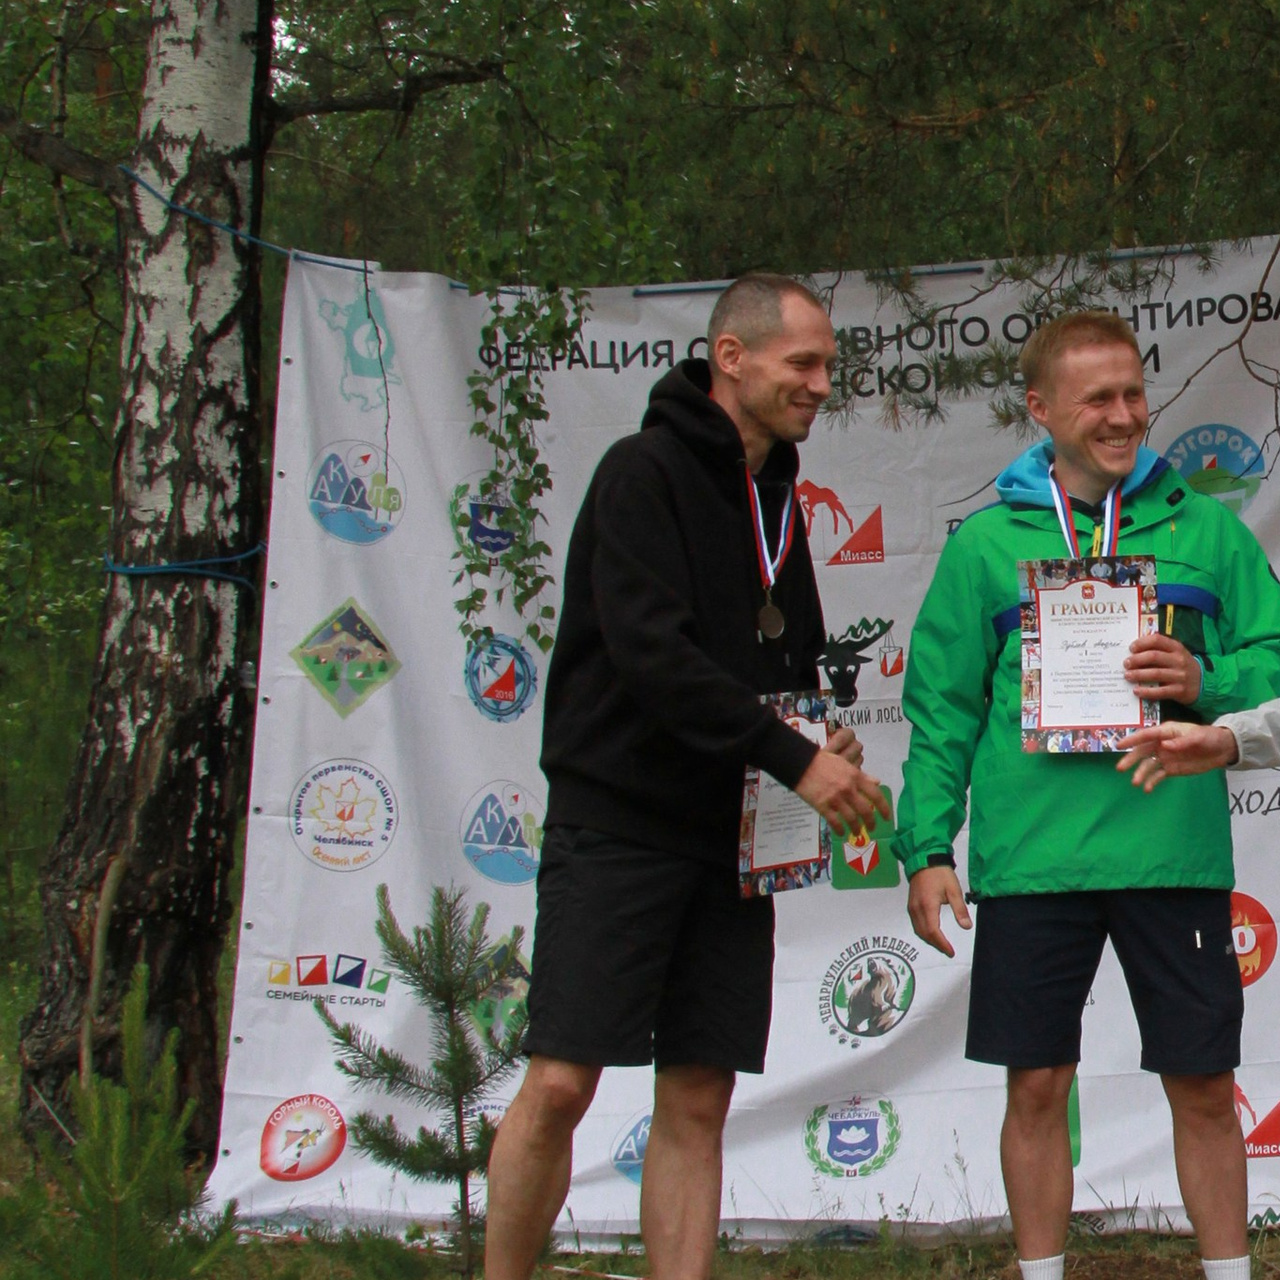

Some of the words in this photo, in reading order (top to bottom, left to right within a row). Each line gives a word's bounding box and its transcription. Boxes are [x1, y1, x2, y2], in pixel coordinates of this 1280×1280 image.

[840, 549, 883, 562] Миасс
[1050, 601, 1128, 616] ГРАМОТА
[494, 689, 515, 700] 2016
[875, 705, 904, 724] ЛОСЬ
[294, 781, 312, 835] Открытое
[311, 764, 375, 782] первенство
[375, 779, 394, 813] СШОР
[313, 834, 374, 847] Челябинск
[819, 936, 870, 1024] ЧЕБАРКУЛЬСКИЙ
[872, 936, 920, 963] МЕДВЕДЬ
[266, 989, 337, 1005] СЕМЕЙНЫЕ
[340, 995, 386, 1007] СТАРТЫ
[269, 1096, 311, 1127] ГОРНЫЙ
[312, 1096, 343, 1130] КОРОЛЬ
[827, 1110, 881, 1120] ЧЕБАРКУЛЬ
